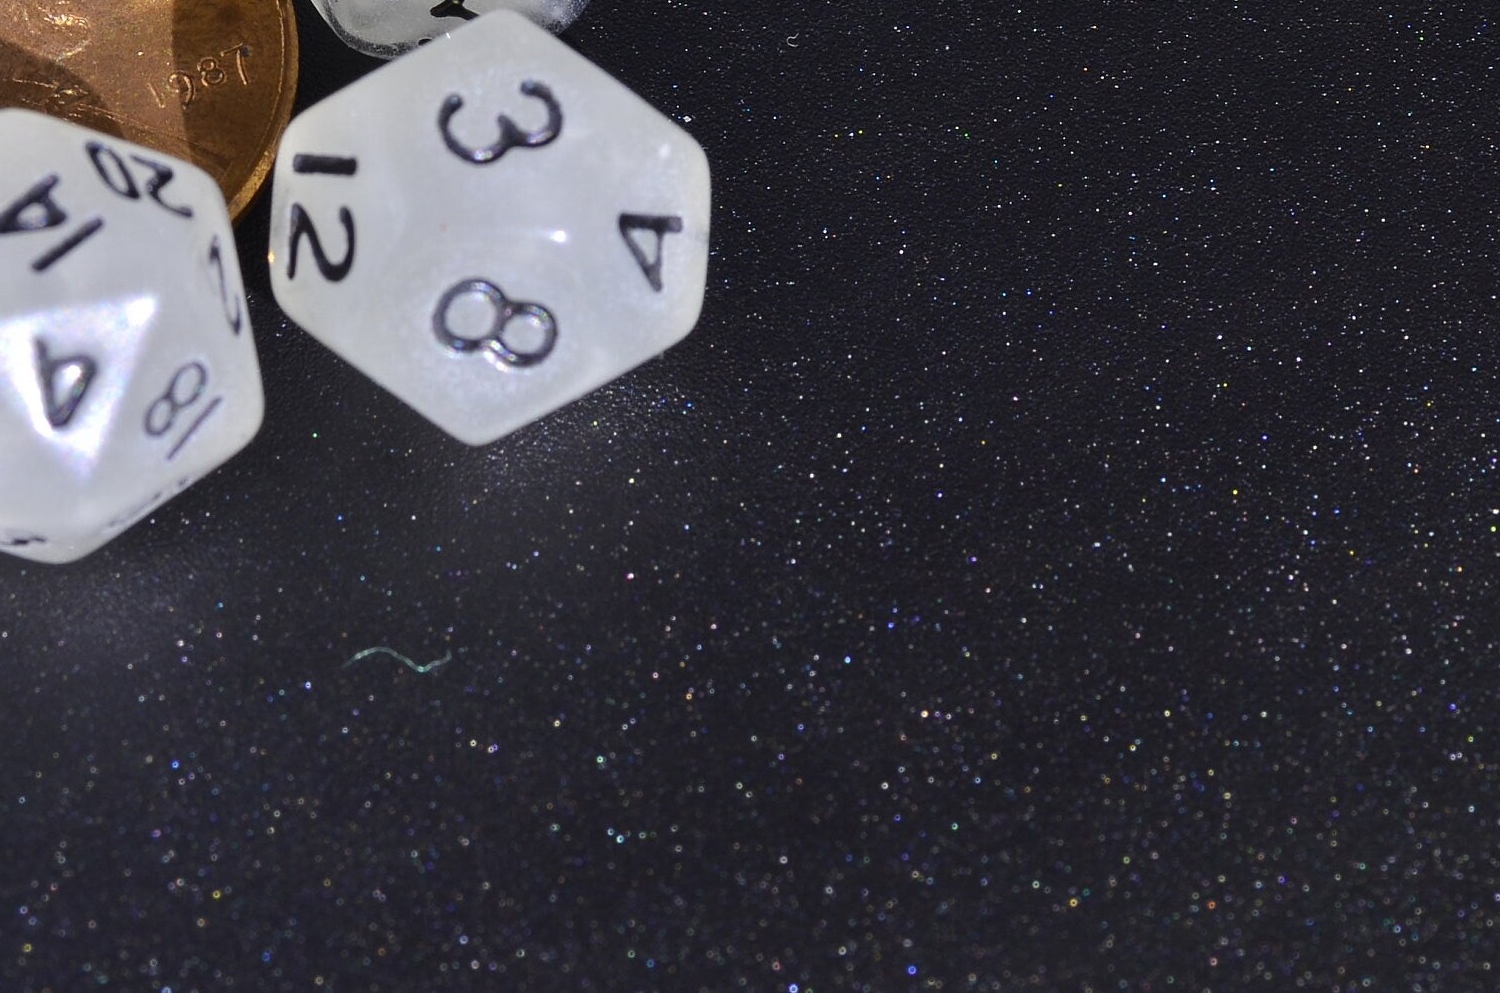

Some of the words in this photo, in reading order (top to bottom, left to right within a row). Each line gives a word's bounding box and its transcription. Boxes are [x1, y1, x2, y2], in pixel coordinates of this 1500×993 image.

[147, 42, 250, 110] 1987
[437, 79, 563, 165] 3
[85, 140, 195, 220] 20
[288, 153, 358, 283] 12
[617, 212, 683, 293] 4
[432, 277, 558, 368] 8
